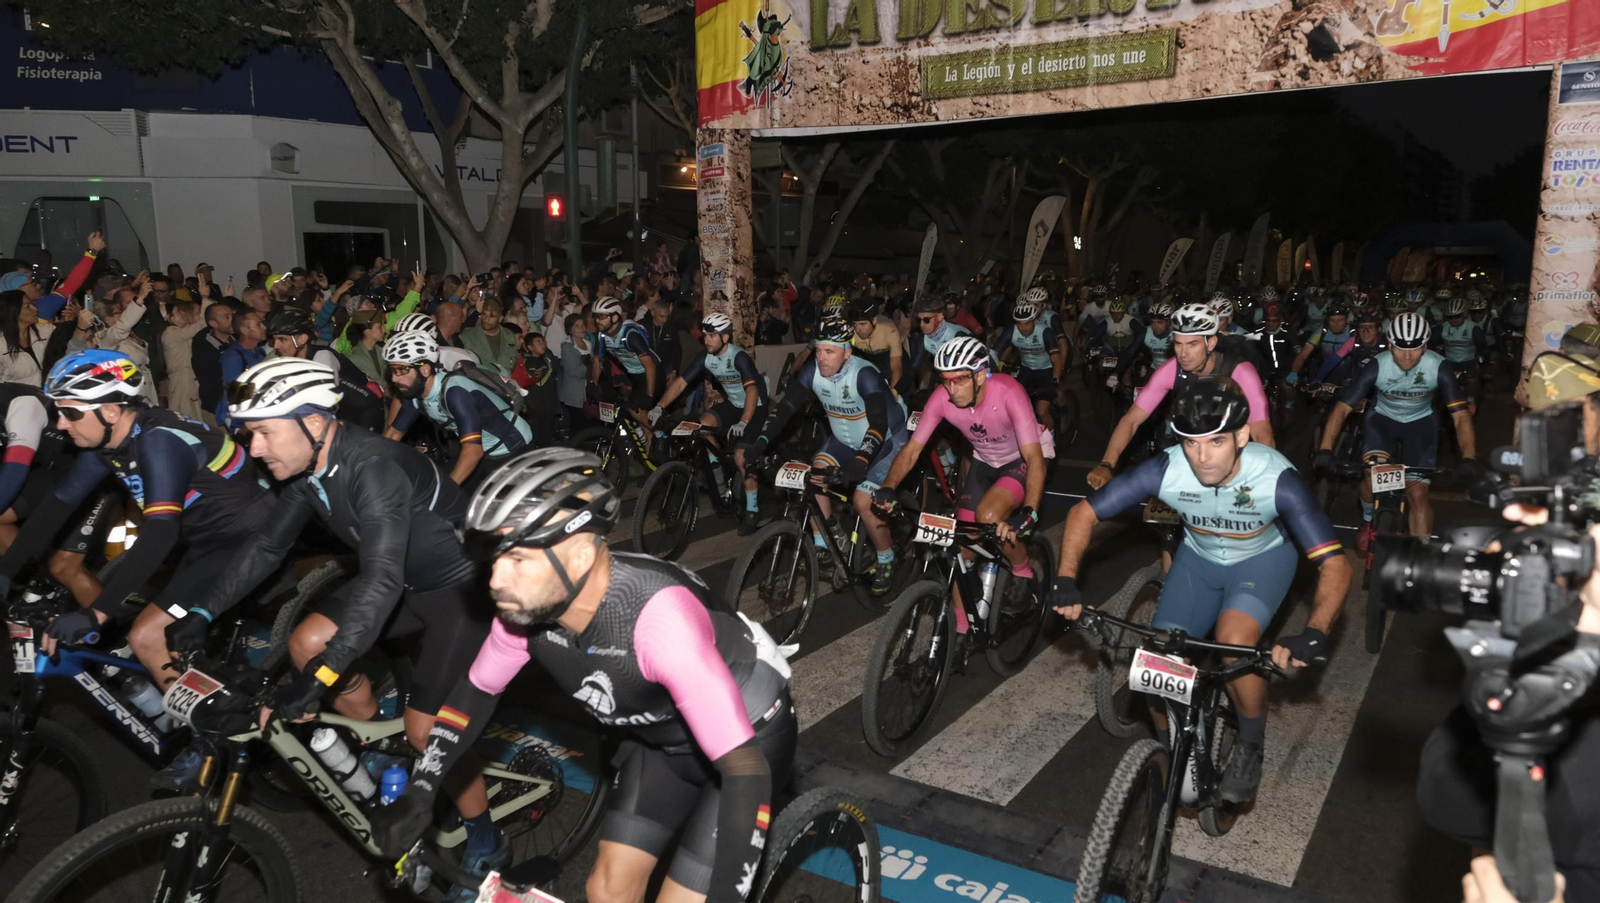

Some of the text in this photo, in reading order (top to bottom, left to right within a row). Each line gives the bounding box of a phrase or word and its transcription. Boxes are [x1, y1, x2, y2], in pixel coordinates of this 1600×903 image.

[809, 0, 882, 49] LA
[17, 66, 102, 82] Fisioterapia
[945, 50, 1147, 83] La Legión y el desierto nos une
[0, 135, 78, 154] ENT
[1537, 290, 1595, 302] primaflor
[781, 469, 804, 481] 7657
[1376, 471, 1402, 485] 8279
[1141, 670, 1187, 695] 9069
[167, 686, 200, 715] 6229
[287, 757, 371, 844] ORBEA
[836, 802, 867, 823] MAXXIS
